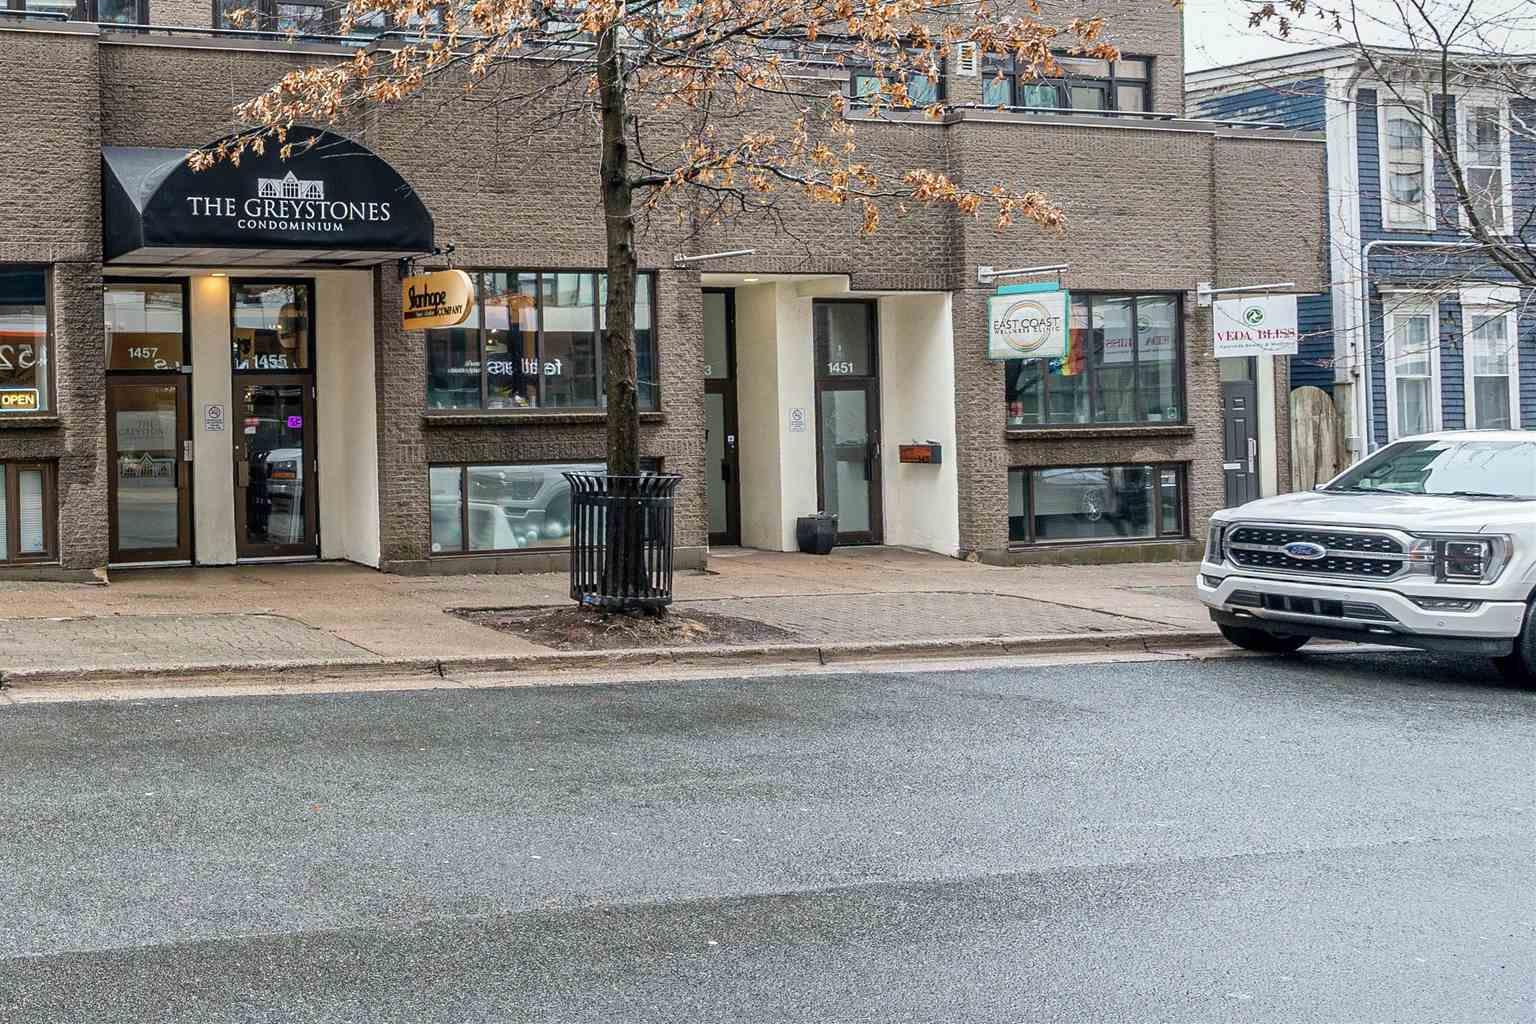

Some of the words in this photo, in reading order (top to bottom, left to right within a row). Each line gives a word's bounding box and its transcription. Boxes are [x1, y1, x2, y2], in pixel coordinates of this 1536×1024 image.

[186, 196, 237, 217] THE
[244, 198, 391, 222] GREYSTONES
[237, 218, 344, 232] CONDOMINIUM
[993, 319, 1020, 330] EAST
[1021, 316, 1061, 329] COAST
[1217, 330, 1252, 342] VEDA
[1257, 327, 1296, 340] BLISS
[127, 346, 159, 359] 1457
[252, 353, 288, 368] 1455
[826, 362, 854, 374] 1451
[1, 394, 35, 406] OPEN
